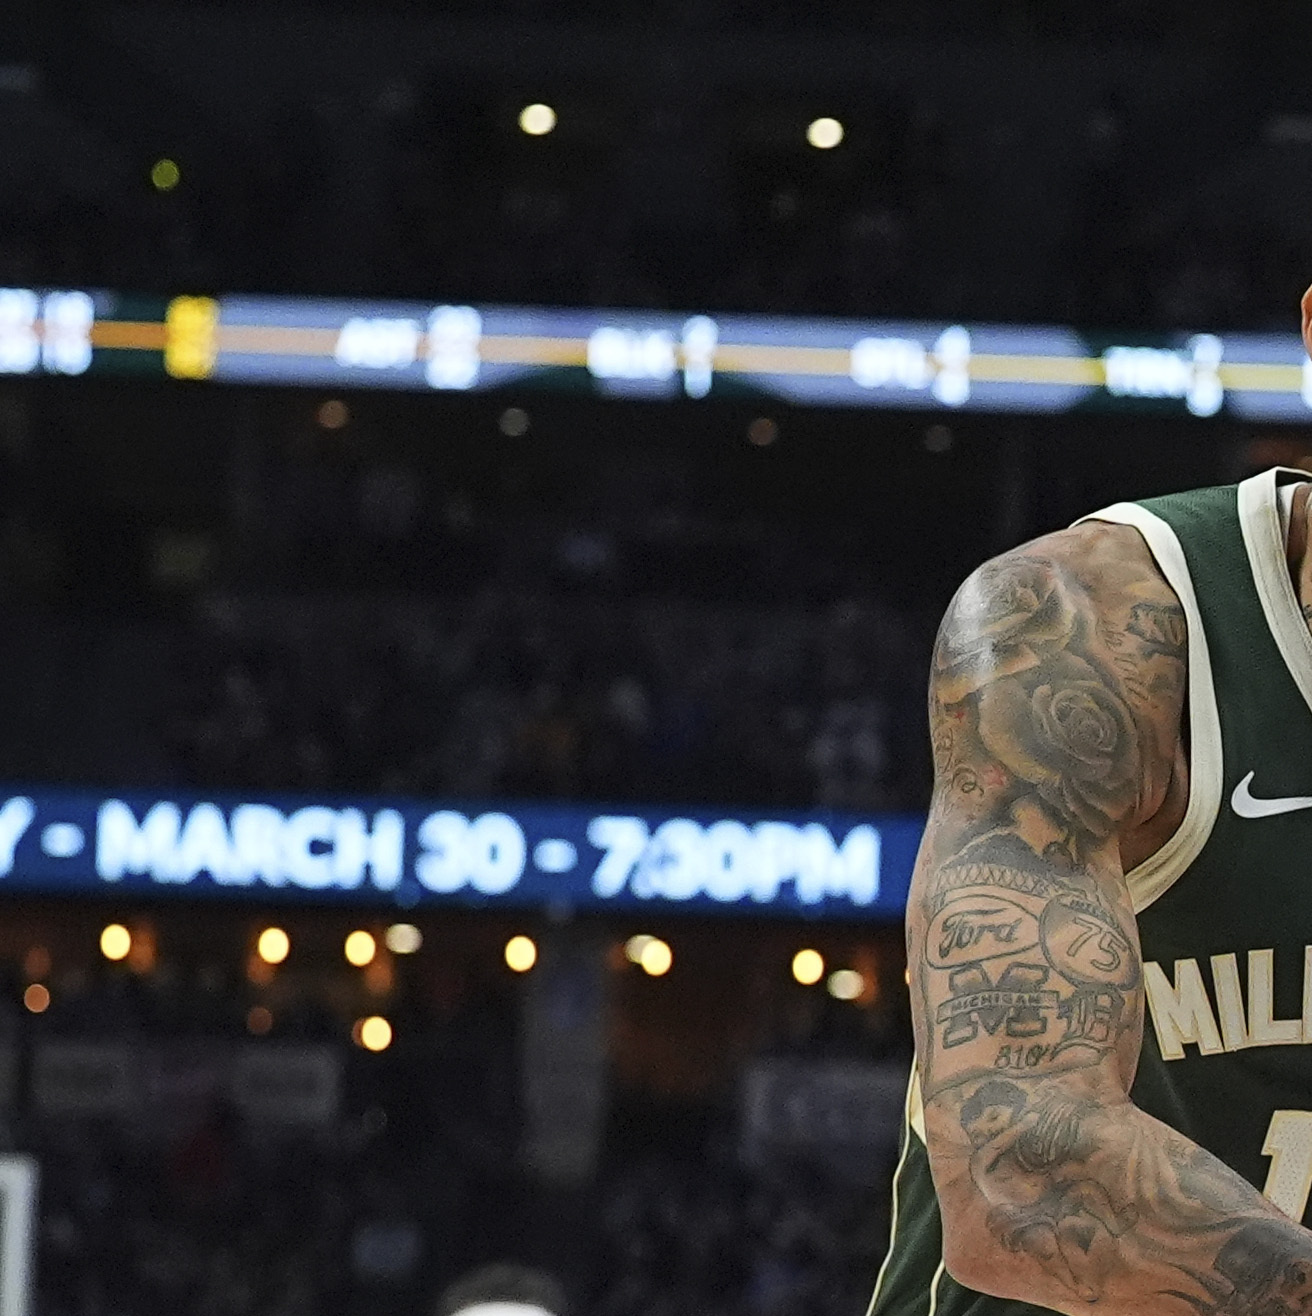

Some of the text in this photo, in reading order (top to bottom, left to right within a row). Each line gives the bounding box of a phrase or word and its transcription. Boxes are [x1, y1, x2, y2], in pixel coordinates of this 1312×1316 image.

[95, 800, 405, 889] MARCH
[415, 810, 527, 894] 30
[587, 816, 881, 905] 7:30PM
[1066, 916, 1128, 973] 75
